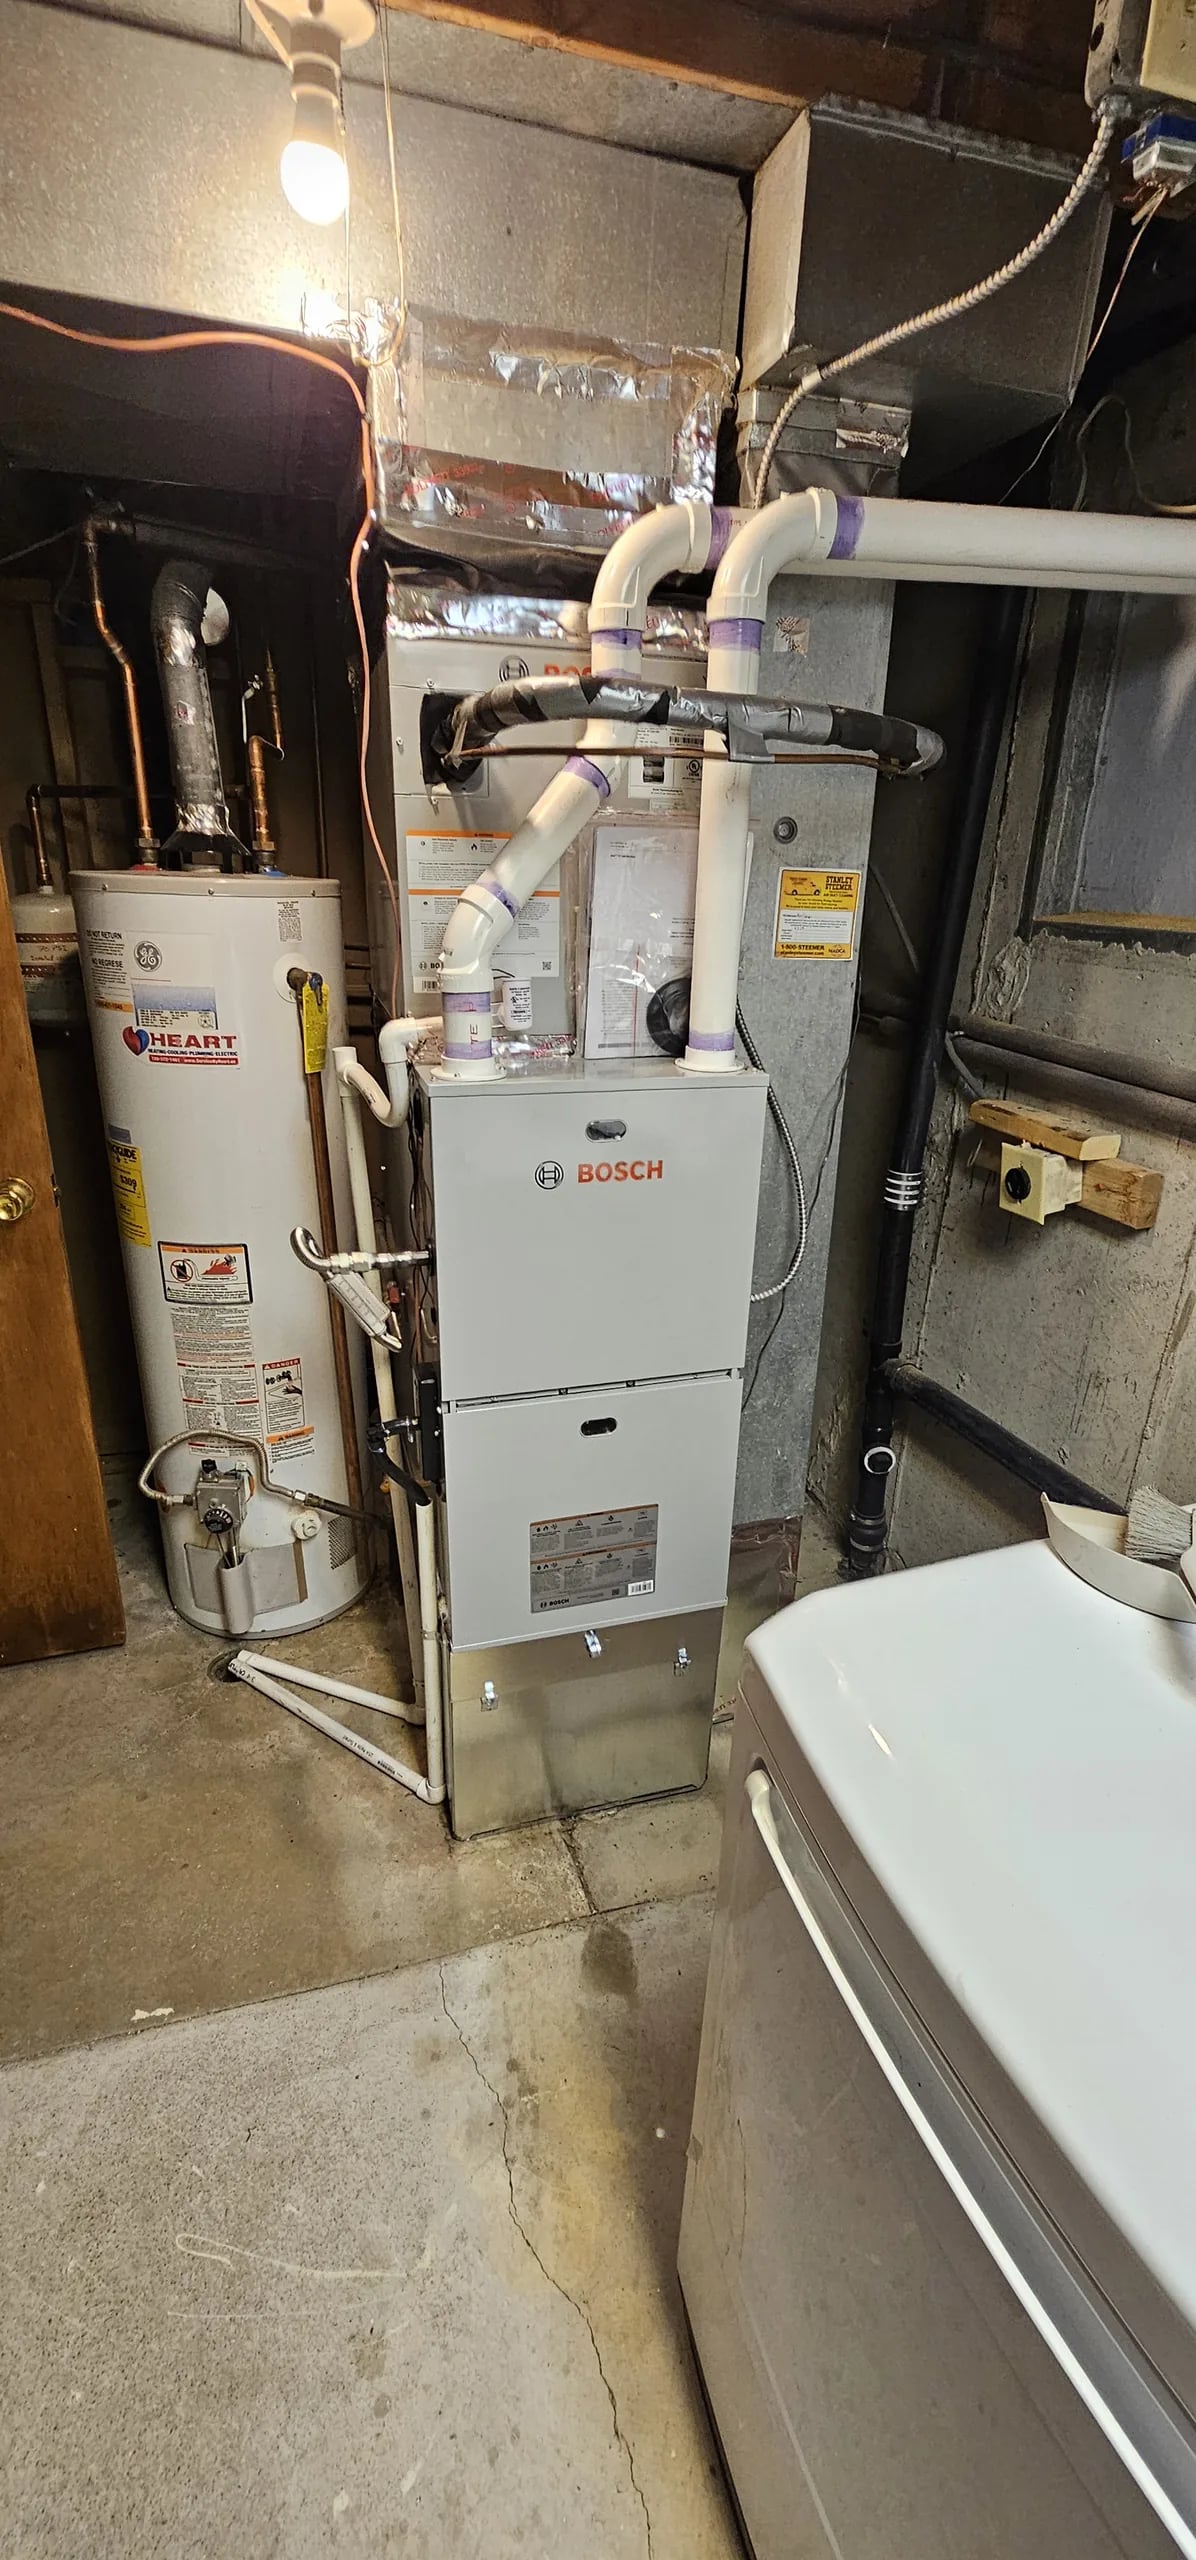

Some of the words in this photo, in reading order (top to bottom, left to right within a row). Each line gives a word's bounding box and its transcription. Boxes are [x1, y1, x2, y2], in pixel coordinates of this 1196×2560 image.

[826, 876, 853, 884] STANLEY
[101, 931, 122, 940] RETURN
[150, 1032, 237, 1049] HEART
[577, 1159, 664, 1184] BOSCH
[271, 1360, 298, 1369] DANGER
[549, 1598, 570, 1606] BOSCH
